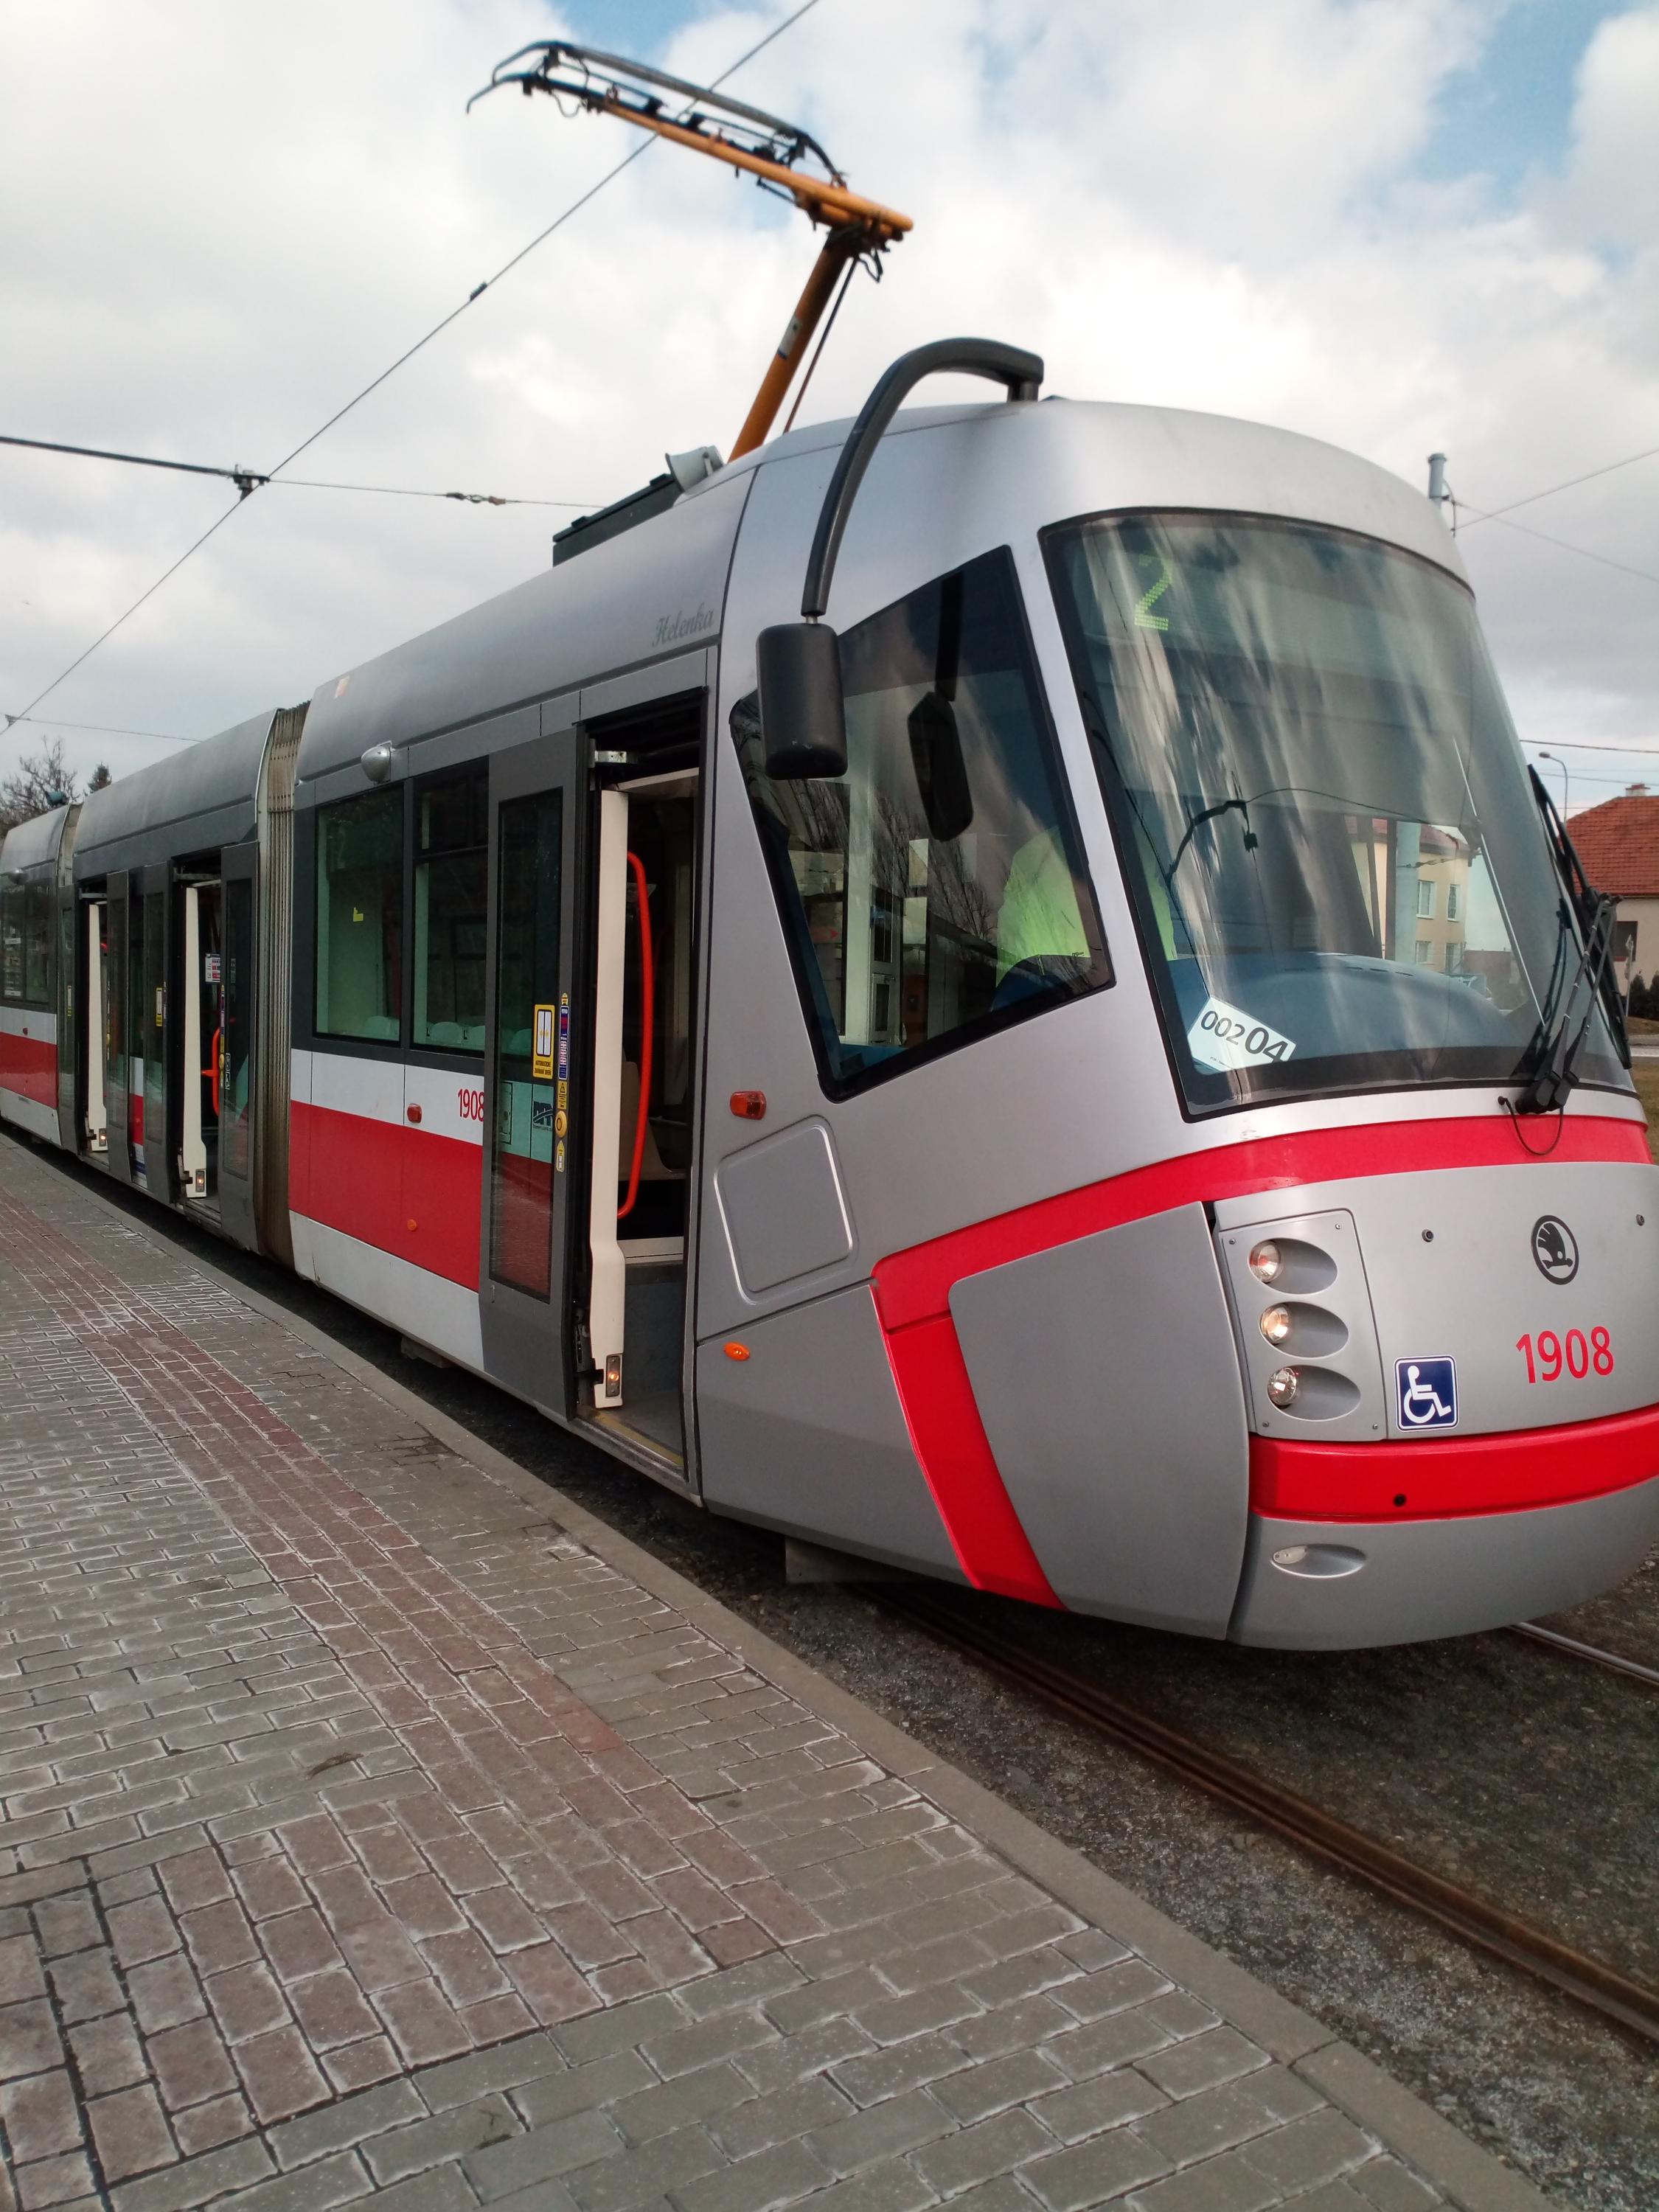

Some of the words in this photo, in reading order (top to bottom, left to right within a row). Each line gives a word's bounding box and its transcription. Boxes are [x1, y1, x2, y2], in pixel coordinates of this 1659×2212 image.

[1135, 554, 1172, 630] 2
[458, 1088, 484, 1121] 1908
[1516, 1326, 1614, 1383] 1908
